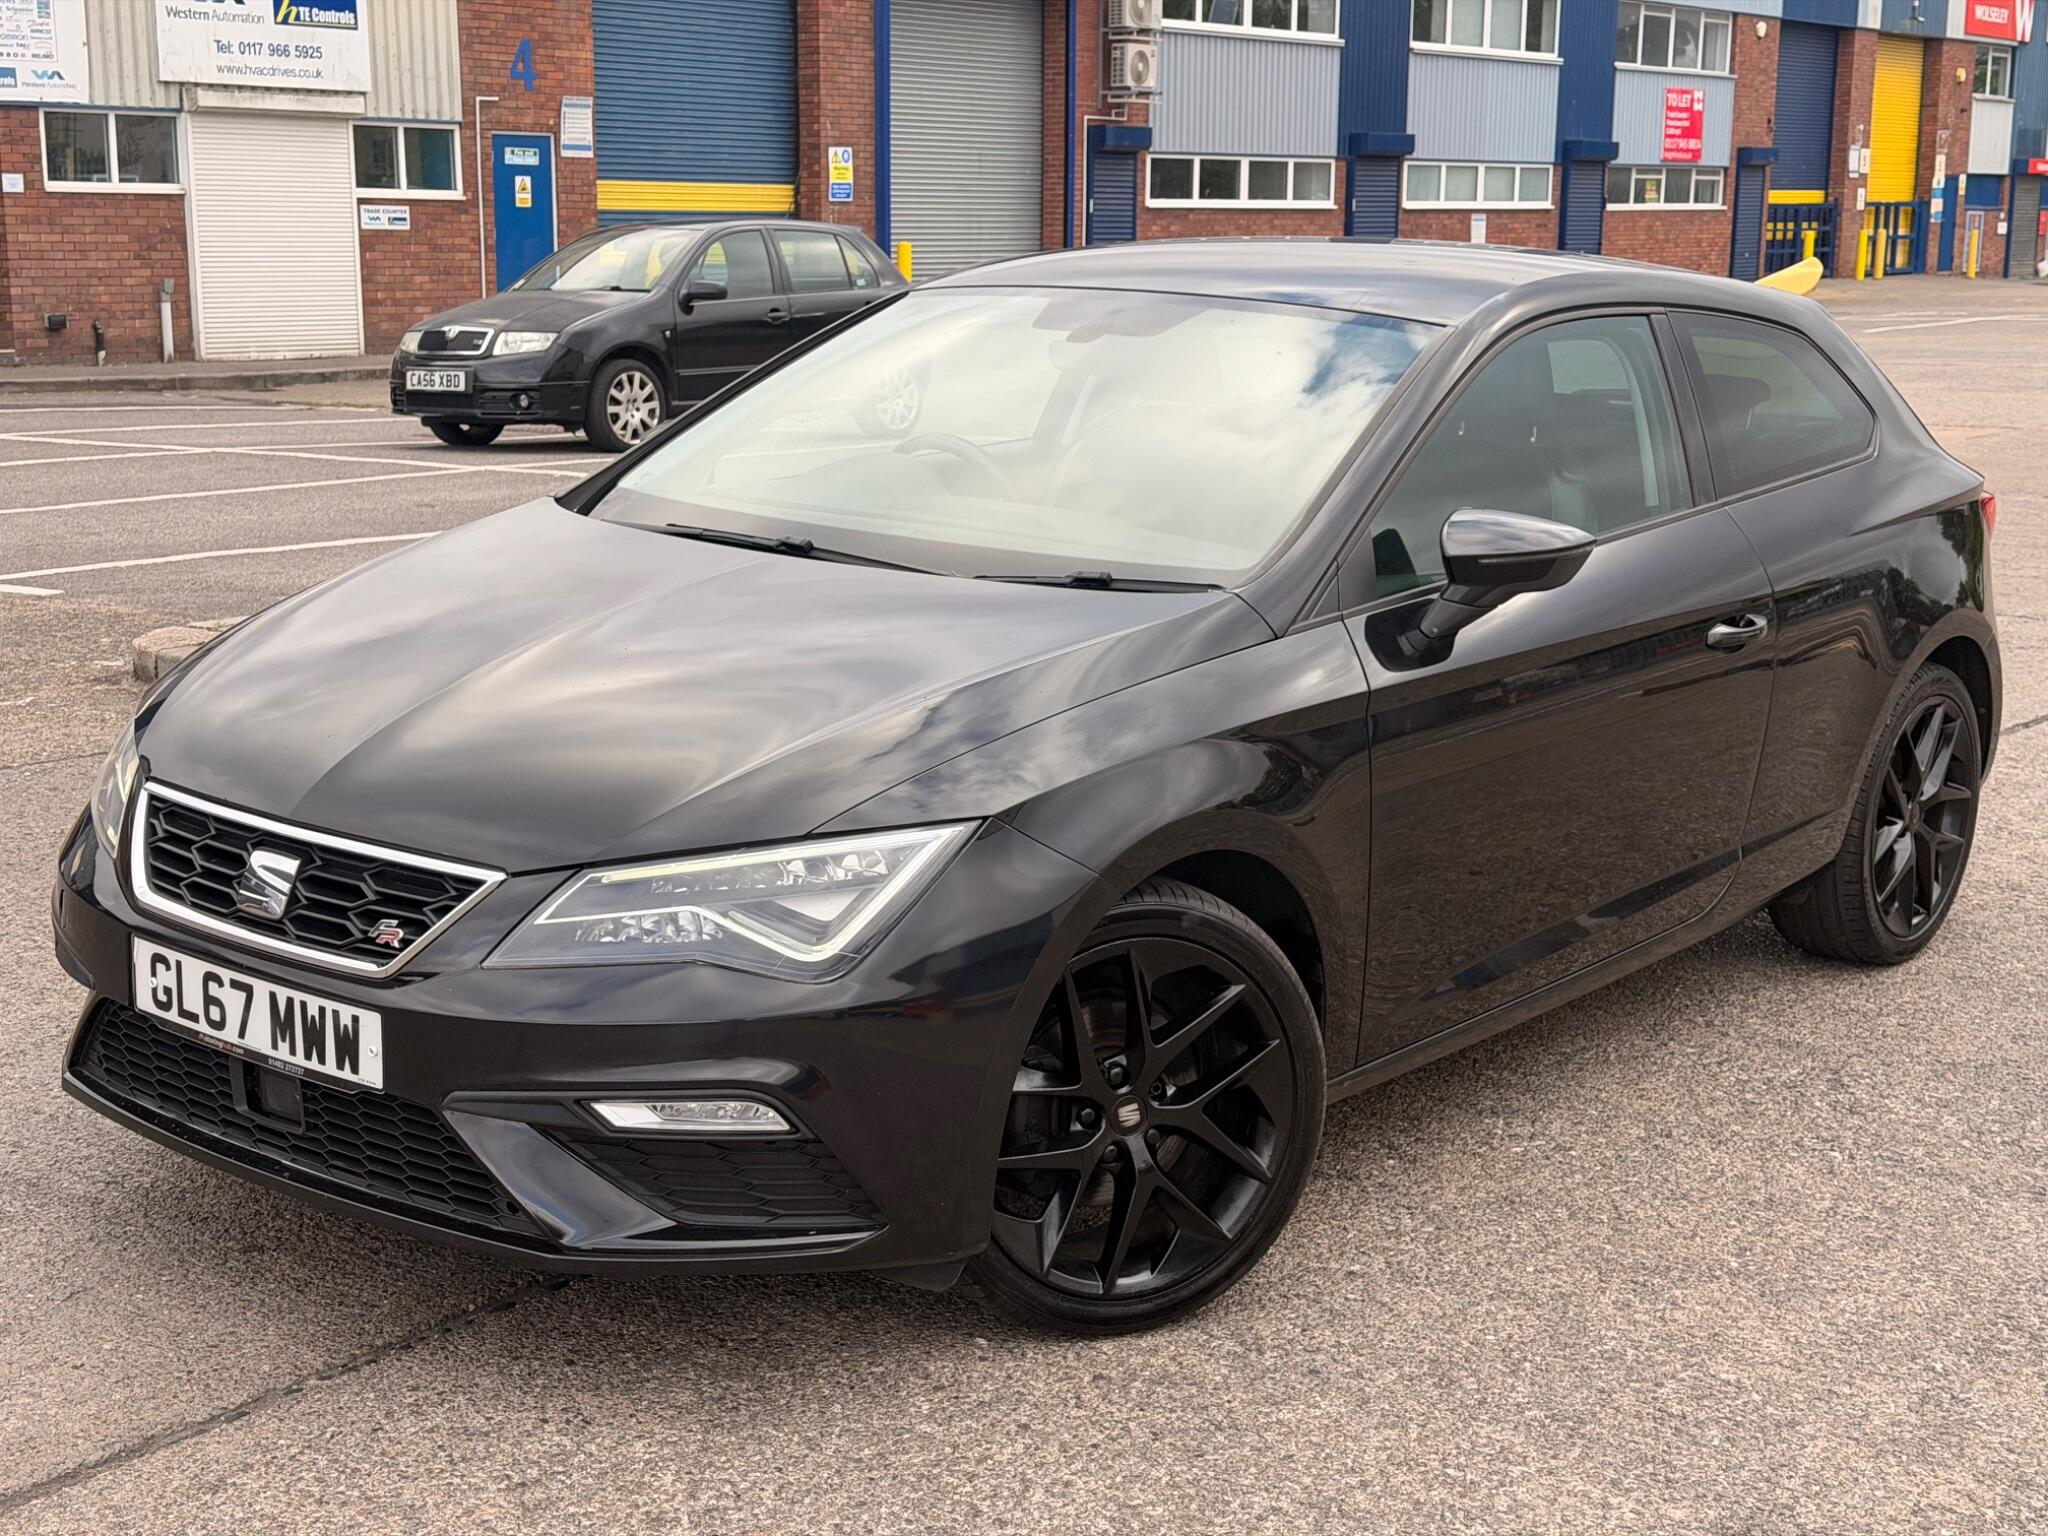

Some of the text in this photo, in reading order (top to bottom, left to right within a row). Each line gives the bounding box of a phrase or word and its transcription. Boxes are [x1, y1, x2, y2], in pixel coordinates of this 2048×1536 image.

[165, 5, 265, 25] Western Automation
[311, 7, 356, 25] Controls
[1974, 4, 2010, 24] WOLSELEY
[214, 39, 323, 60] Tel: 0117 966 5925
[216, 63, 324, 79] www.hvacdrives.co.uk
[510, 39, 537, 92] 4
[1679, 94, 1692, 109] LET
[409, 372, 461, 389] CA56 XBD
[149, 951, 361, 1077] GL67 MWW
